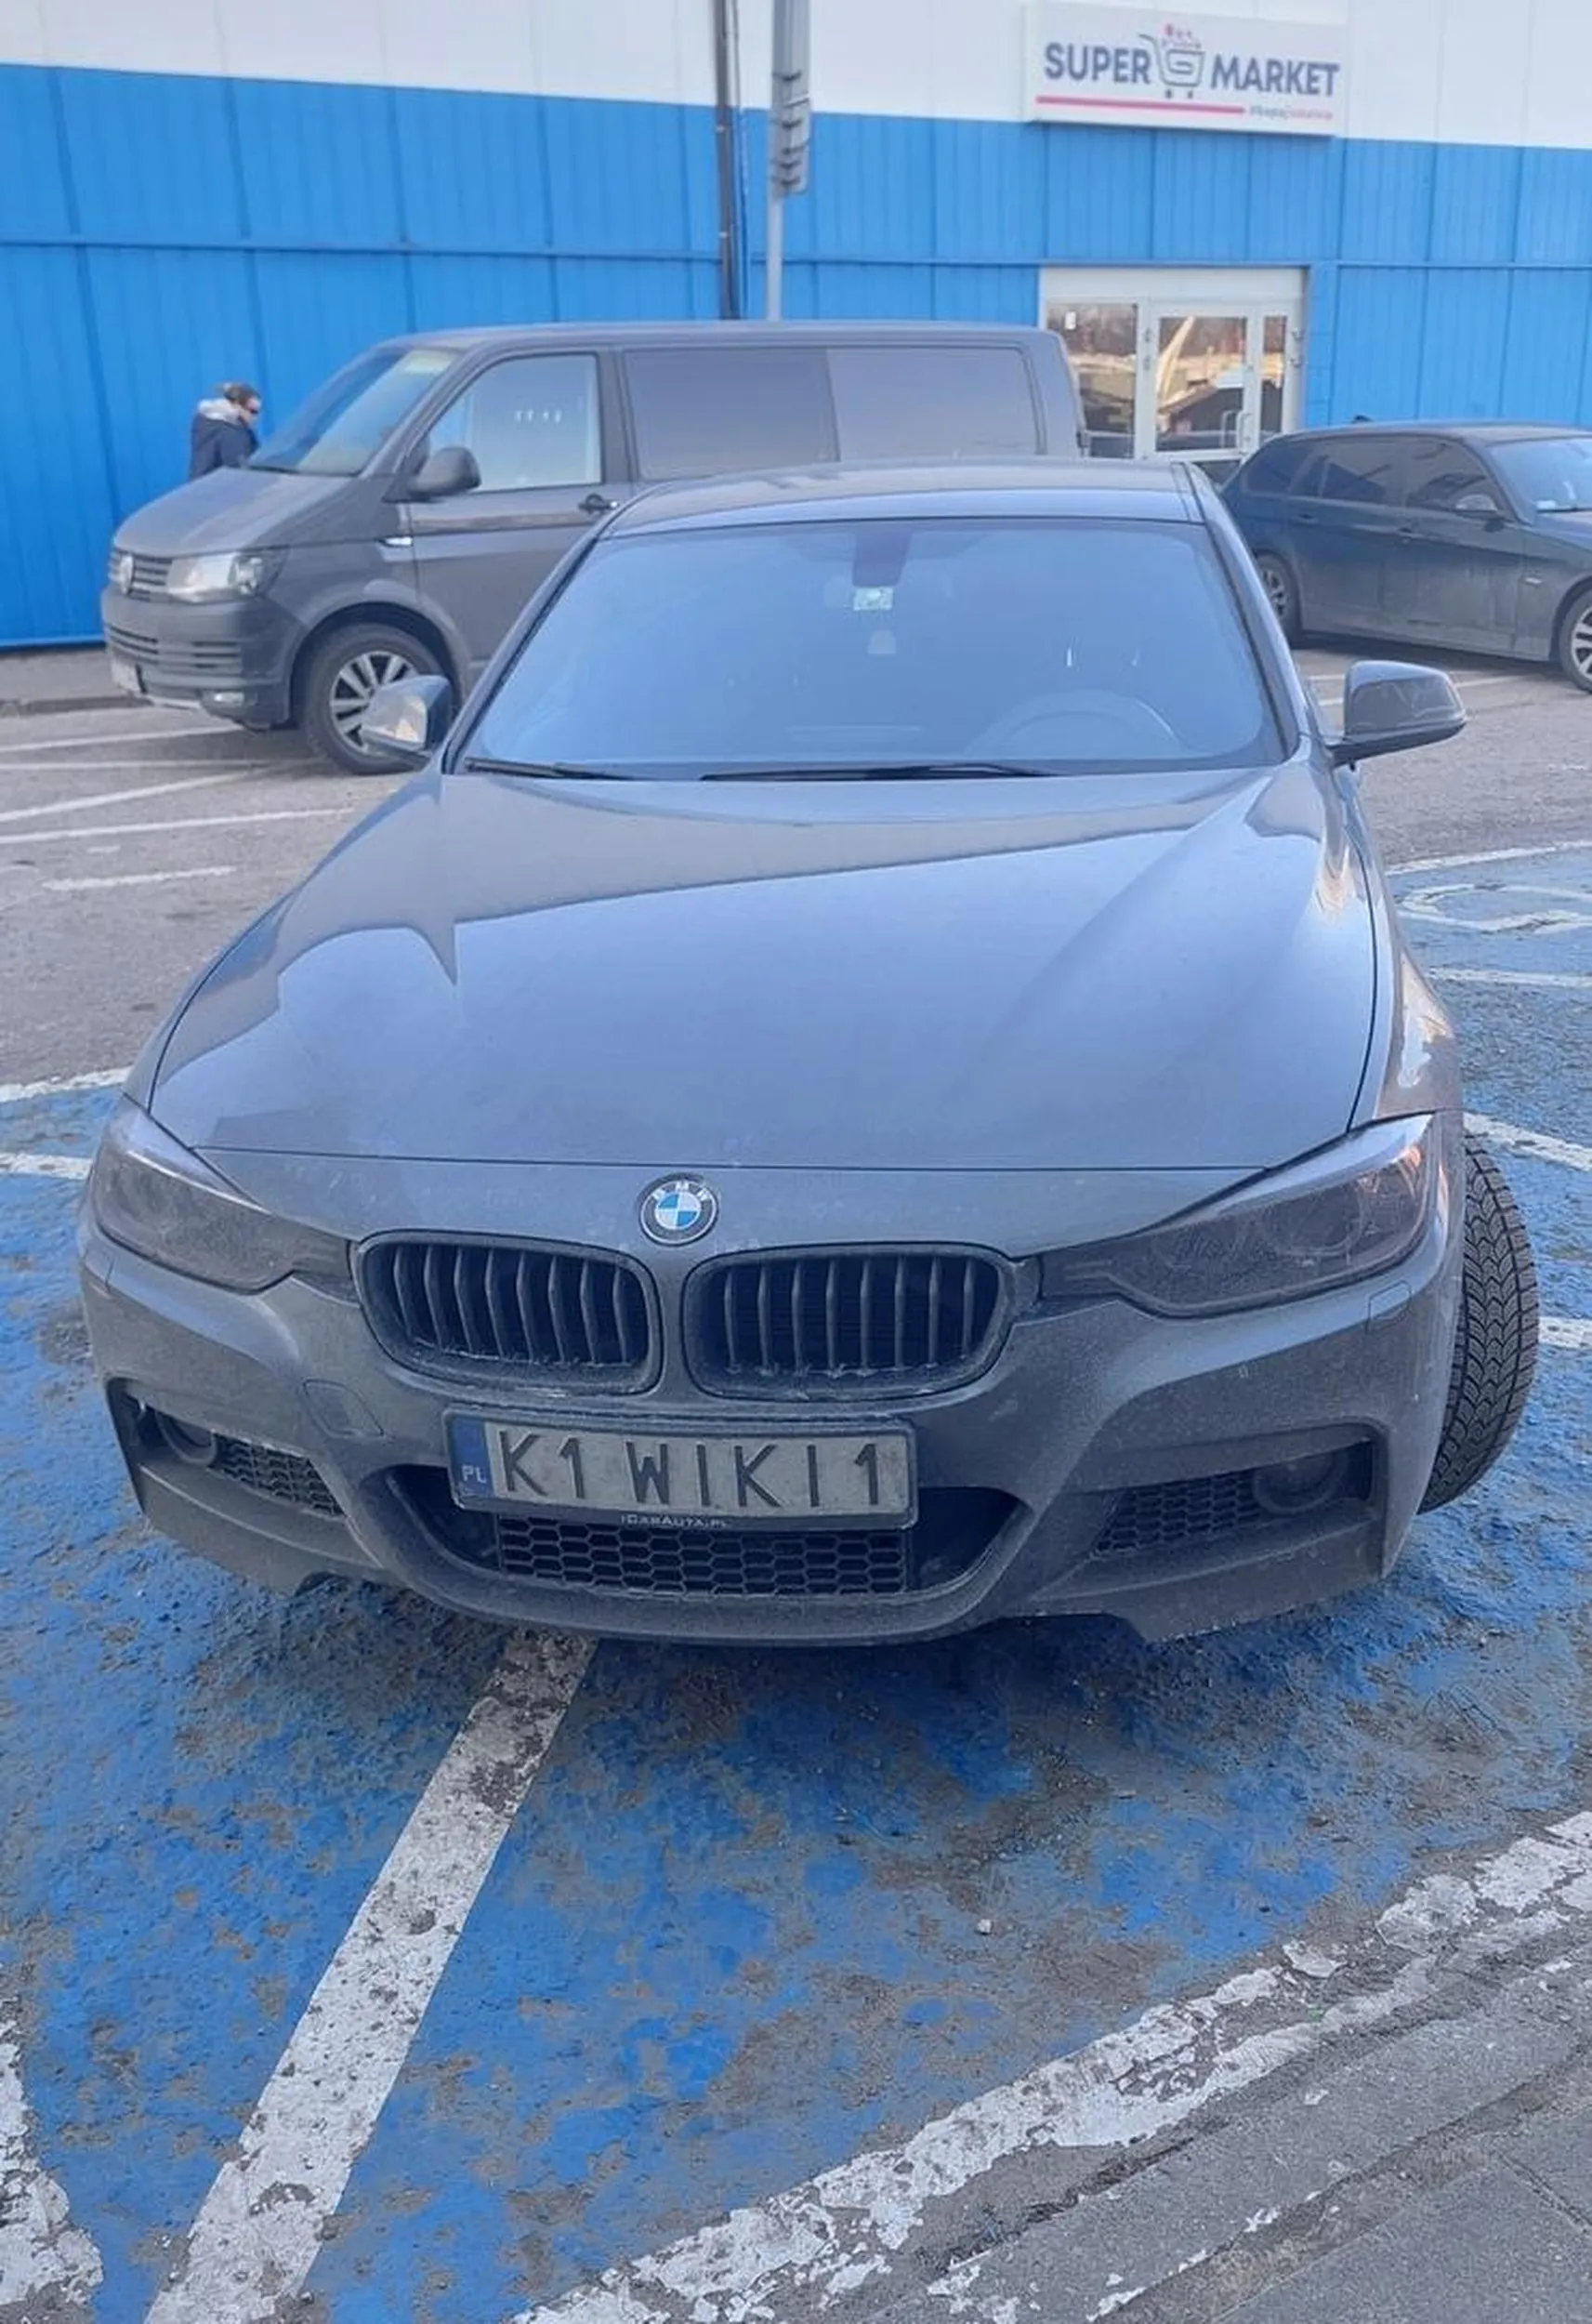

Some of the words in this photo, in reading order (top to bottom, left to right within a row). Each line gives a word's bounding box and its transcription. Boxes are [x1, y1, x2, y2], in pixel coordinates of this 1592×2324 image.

[1045, 43, 1151, 85] SUPER
[1211, 54, 1340, 97] MARKET
[651, 1182, 710, 1201] BMW
[462, 1465, 487, 1484] PL
[498, 1430, 585, 1499] K1
[625, 1441, 878, 1507] WIKI1
